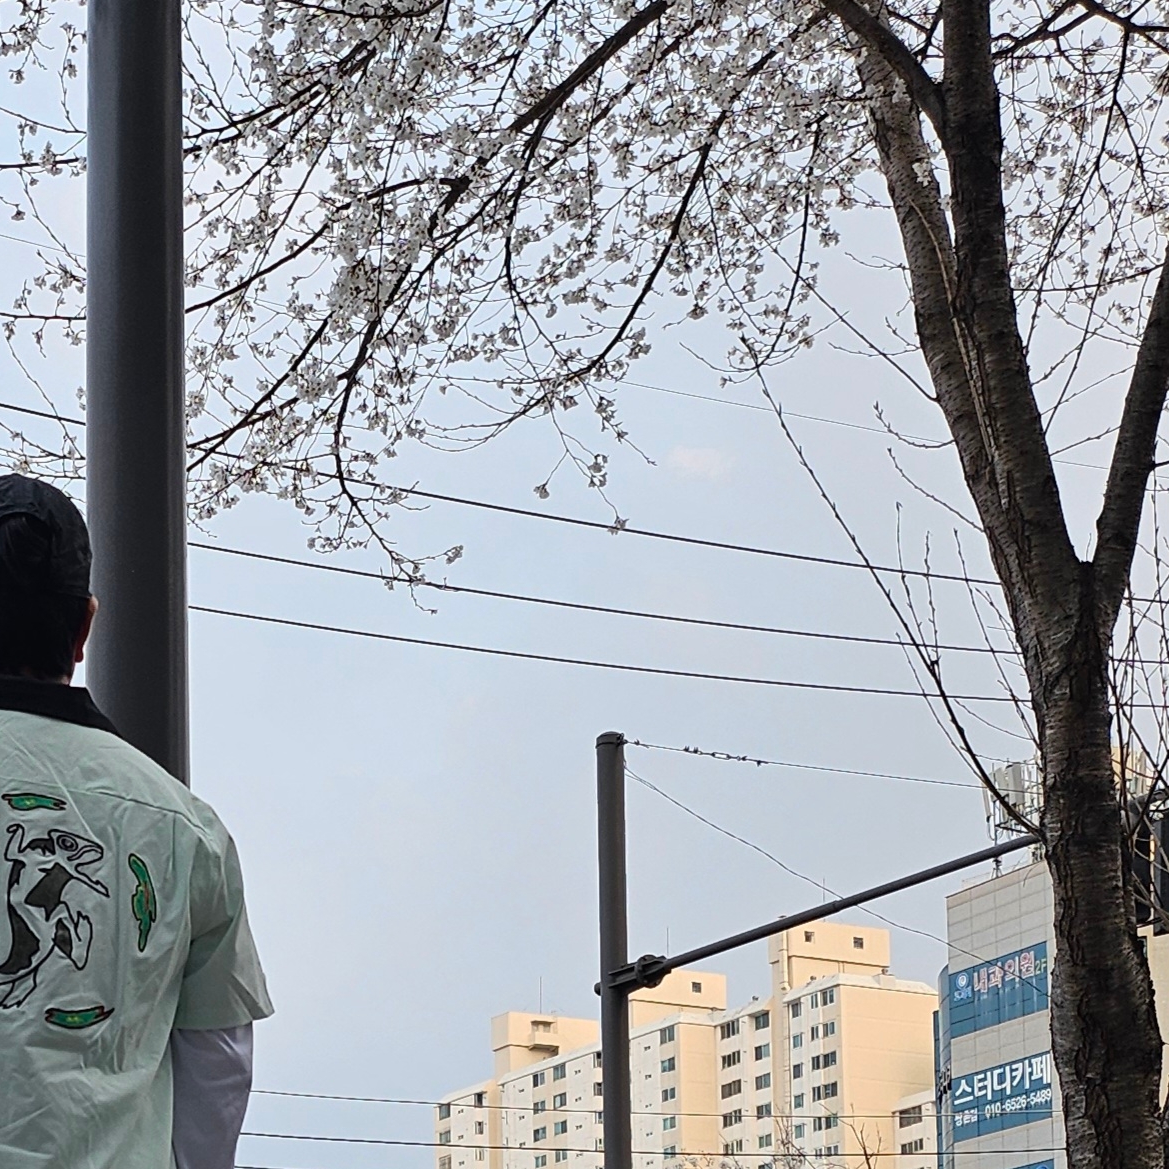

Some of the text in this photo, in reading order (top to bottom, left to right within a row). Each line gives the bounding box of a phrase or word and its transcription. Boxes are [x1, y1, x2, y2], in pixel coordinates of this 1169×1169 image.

[973, 951, 1047, 993] 내과의원 2F
[953, 1053, 1051, 1105] 스터디카페
[984, 1088, 1051, 1120] 010-6526-5489
